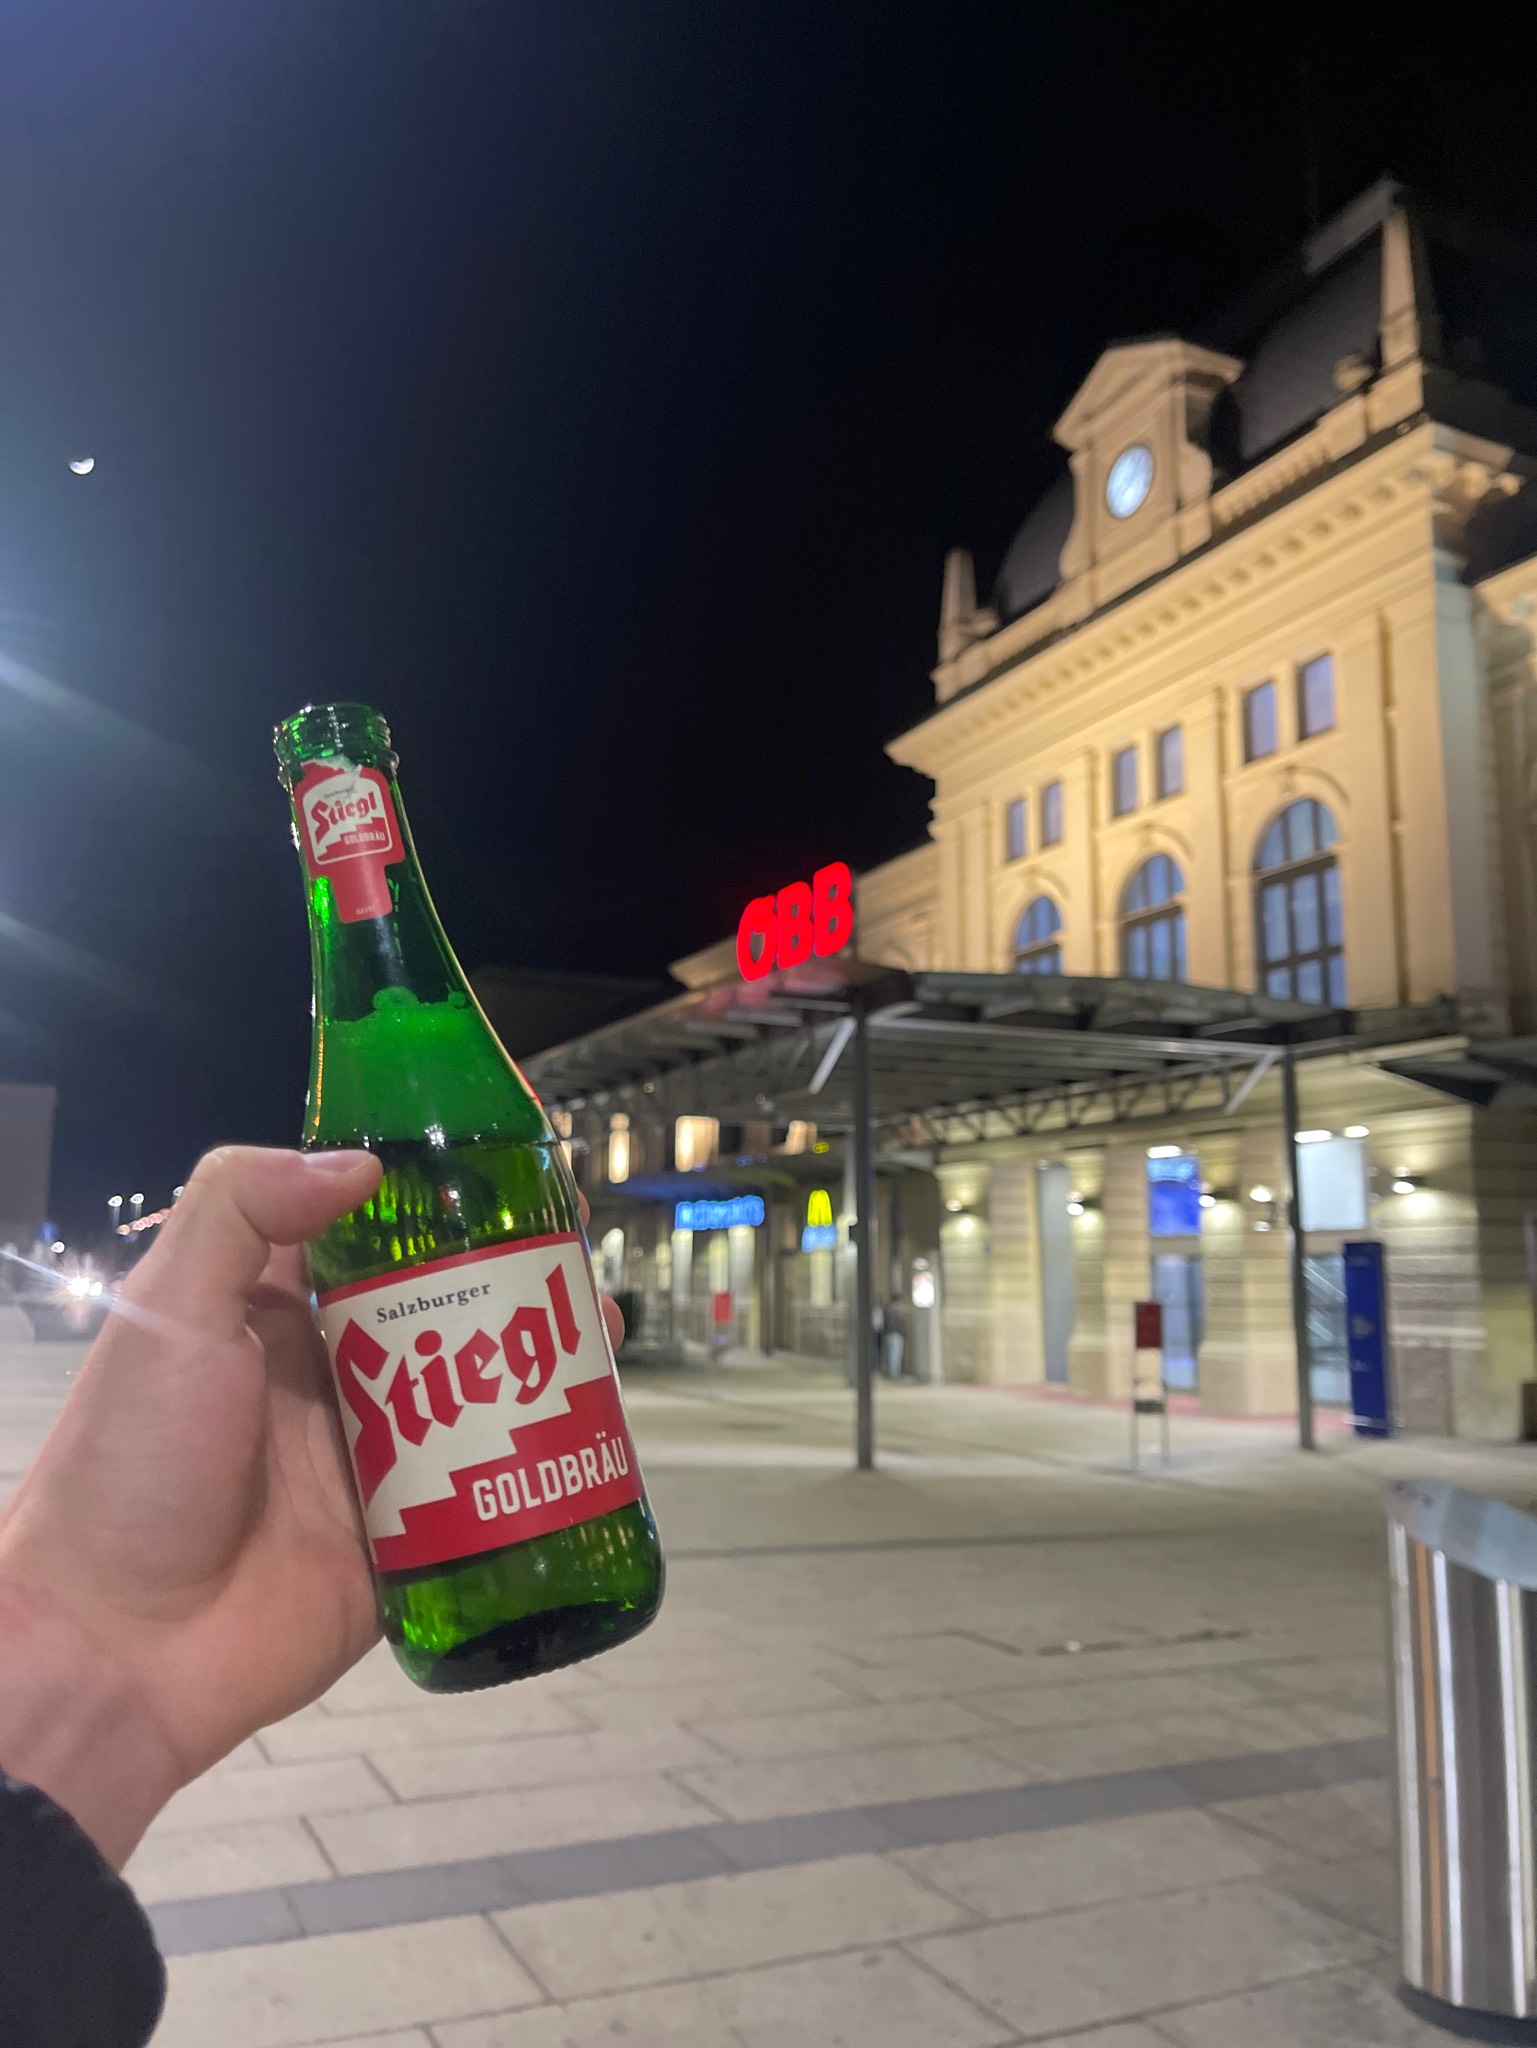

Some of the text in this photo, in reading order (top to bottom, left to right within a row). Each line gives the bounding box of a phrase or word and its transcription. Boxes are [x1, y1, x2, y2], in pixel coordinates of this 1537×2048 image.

[311, 791, 377, 845] Stiegl
[376, 1282, 491, 1324] Salzburger
[335, 1263, 581, 1512] Stiegl
[472, 1431, 629, 1521] GOLDBRÄU
